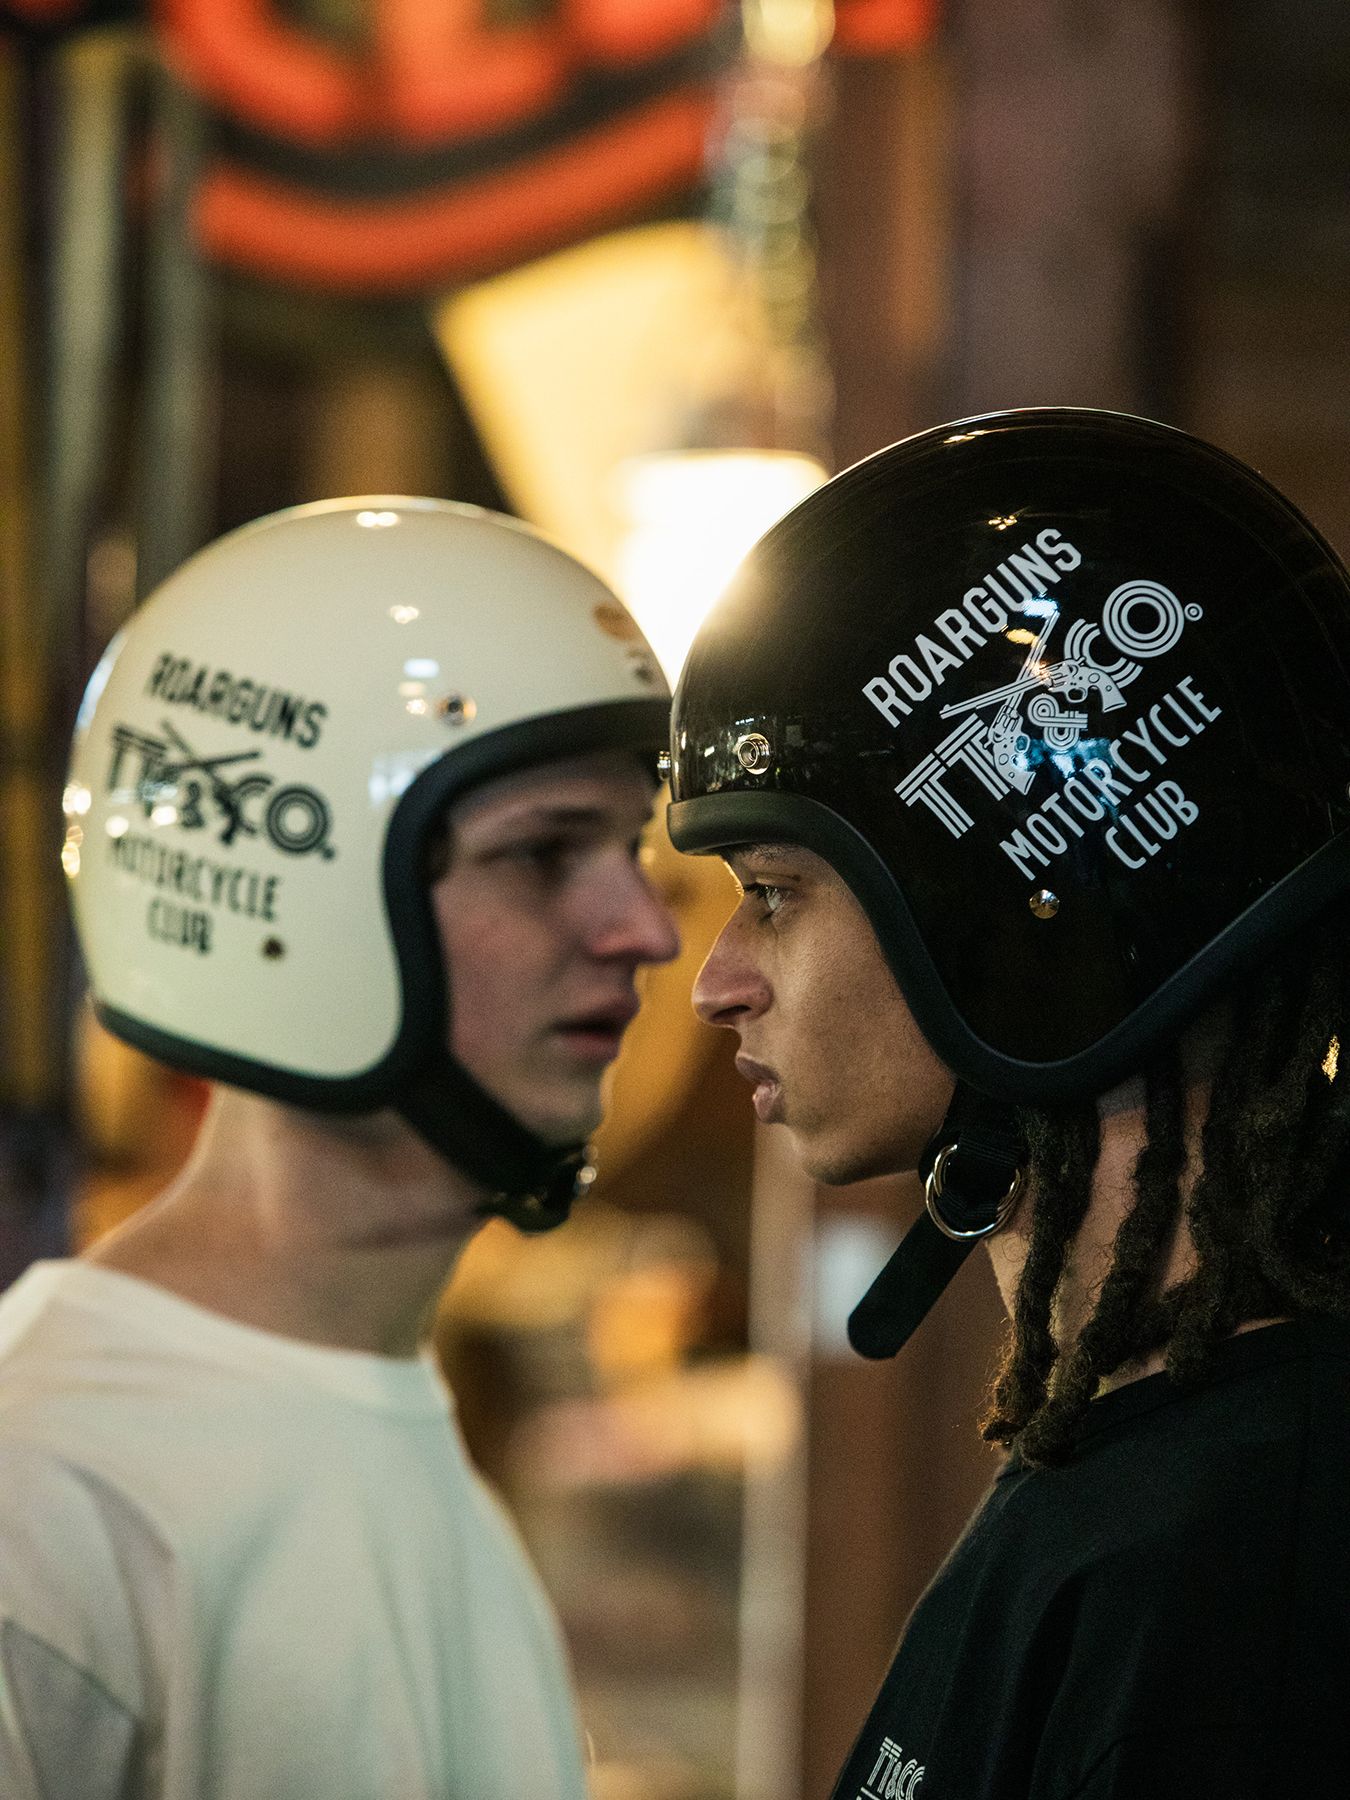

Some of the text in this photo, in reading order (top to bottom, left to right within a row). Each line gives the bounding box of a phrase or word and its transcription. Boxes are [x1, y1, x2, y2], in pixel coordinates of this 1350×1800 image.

[862, 528, 1081, 728] ROARGUNS
[147, 652, 327, 749] ROARGUNS
[1000, 675, 1222, 880] MOTORCYCLE
[1105, 780, 1199, 869] CLUB
[147, 896, 213, 955] CLUB
